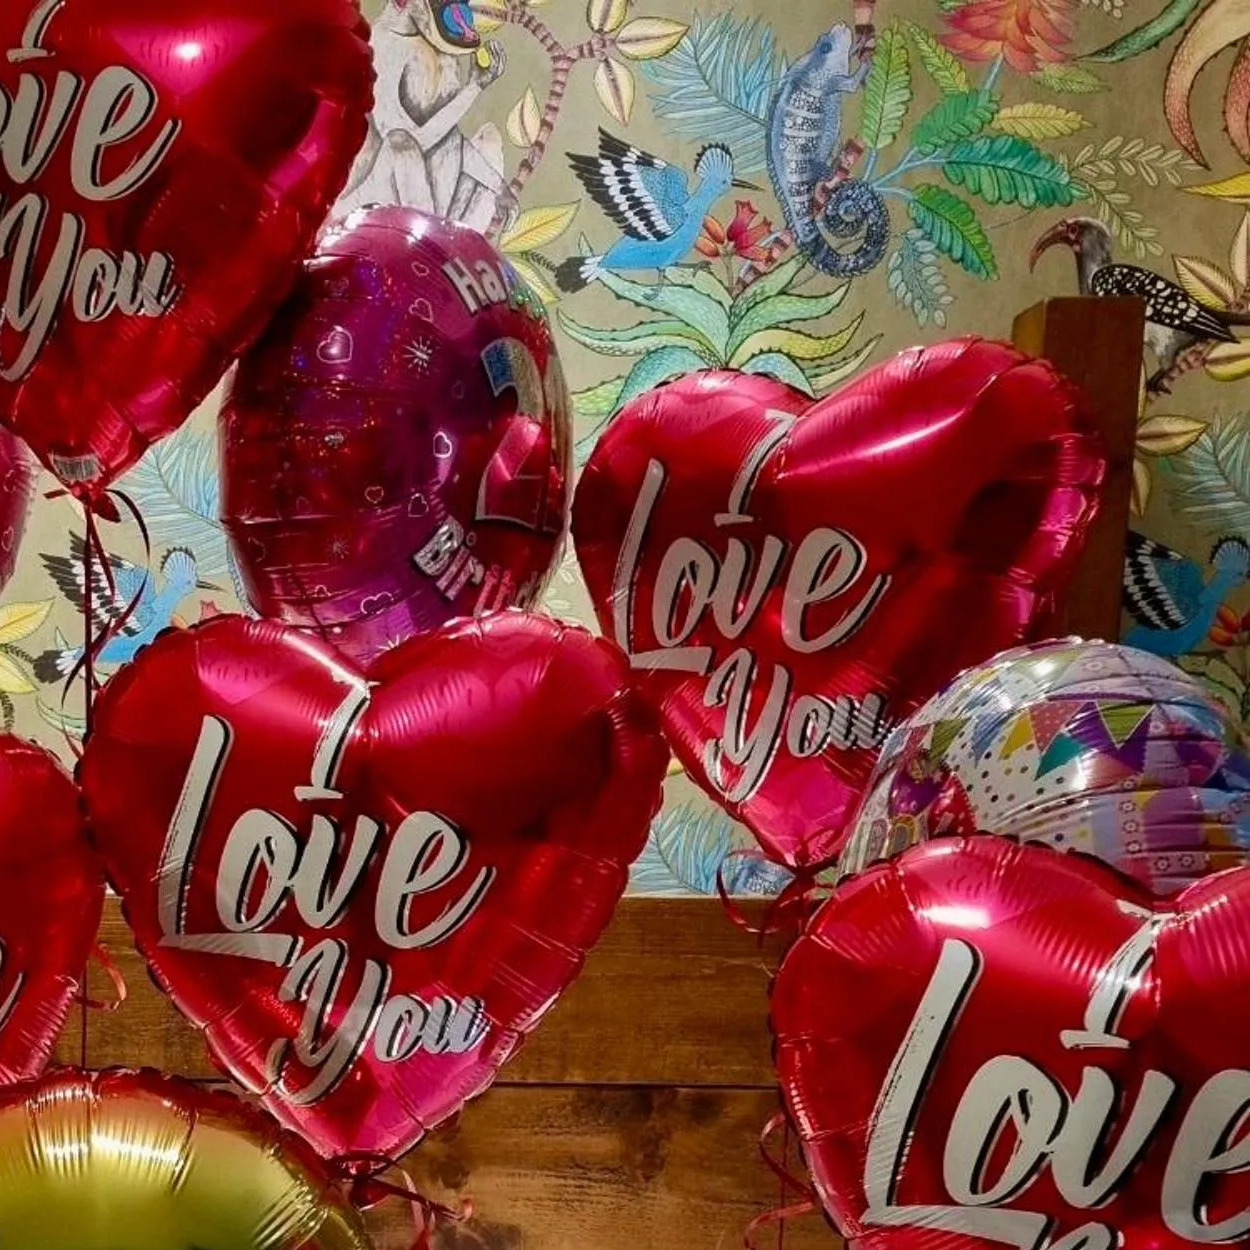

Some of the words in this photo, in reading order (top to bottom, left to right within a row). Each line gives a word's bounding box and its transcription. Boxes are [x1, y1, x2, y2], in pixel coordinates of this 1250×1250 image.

[713, 409, 797, 527] I
[612, 458, 893, 675] Love
[294, 680, 380, 800] I
[703, 647, 891, 802] You
[157, 715, 497, 967] Love
[265, 938, 490, 1106] You
[1059, 898, 1182, 1050] I
